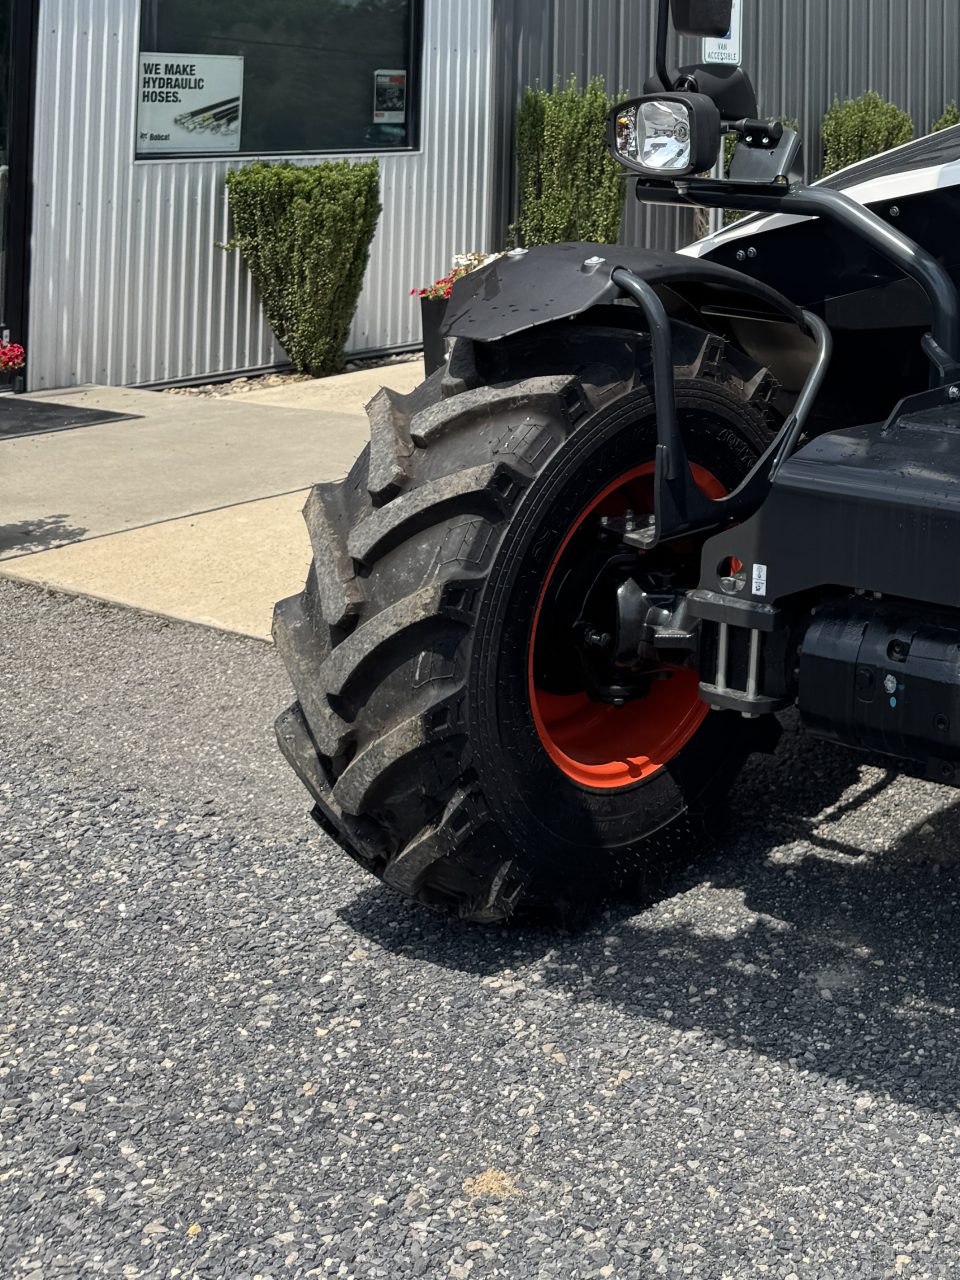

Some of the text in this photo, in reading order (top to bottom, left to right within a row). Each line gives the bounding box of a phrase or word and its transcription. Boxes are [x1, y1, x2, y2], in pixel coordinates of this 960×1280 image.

[717, 42, 728, 51] VAN
[707, 51, 737, 61] ACCESSIBLE
[143, 62, 196, 76] WE MAKE
[142, 77, 205, 90] HYDRAULIC
[142, 90, 182, 103] HOSES.
[149, 133, 170, 141] Bobcat
